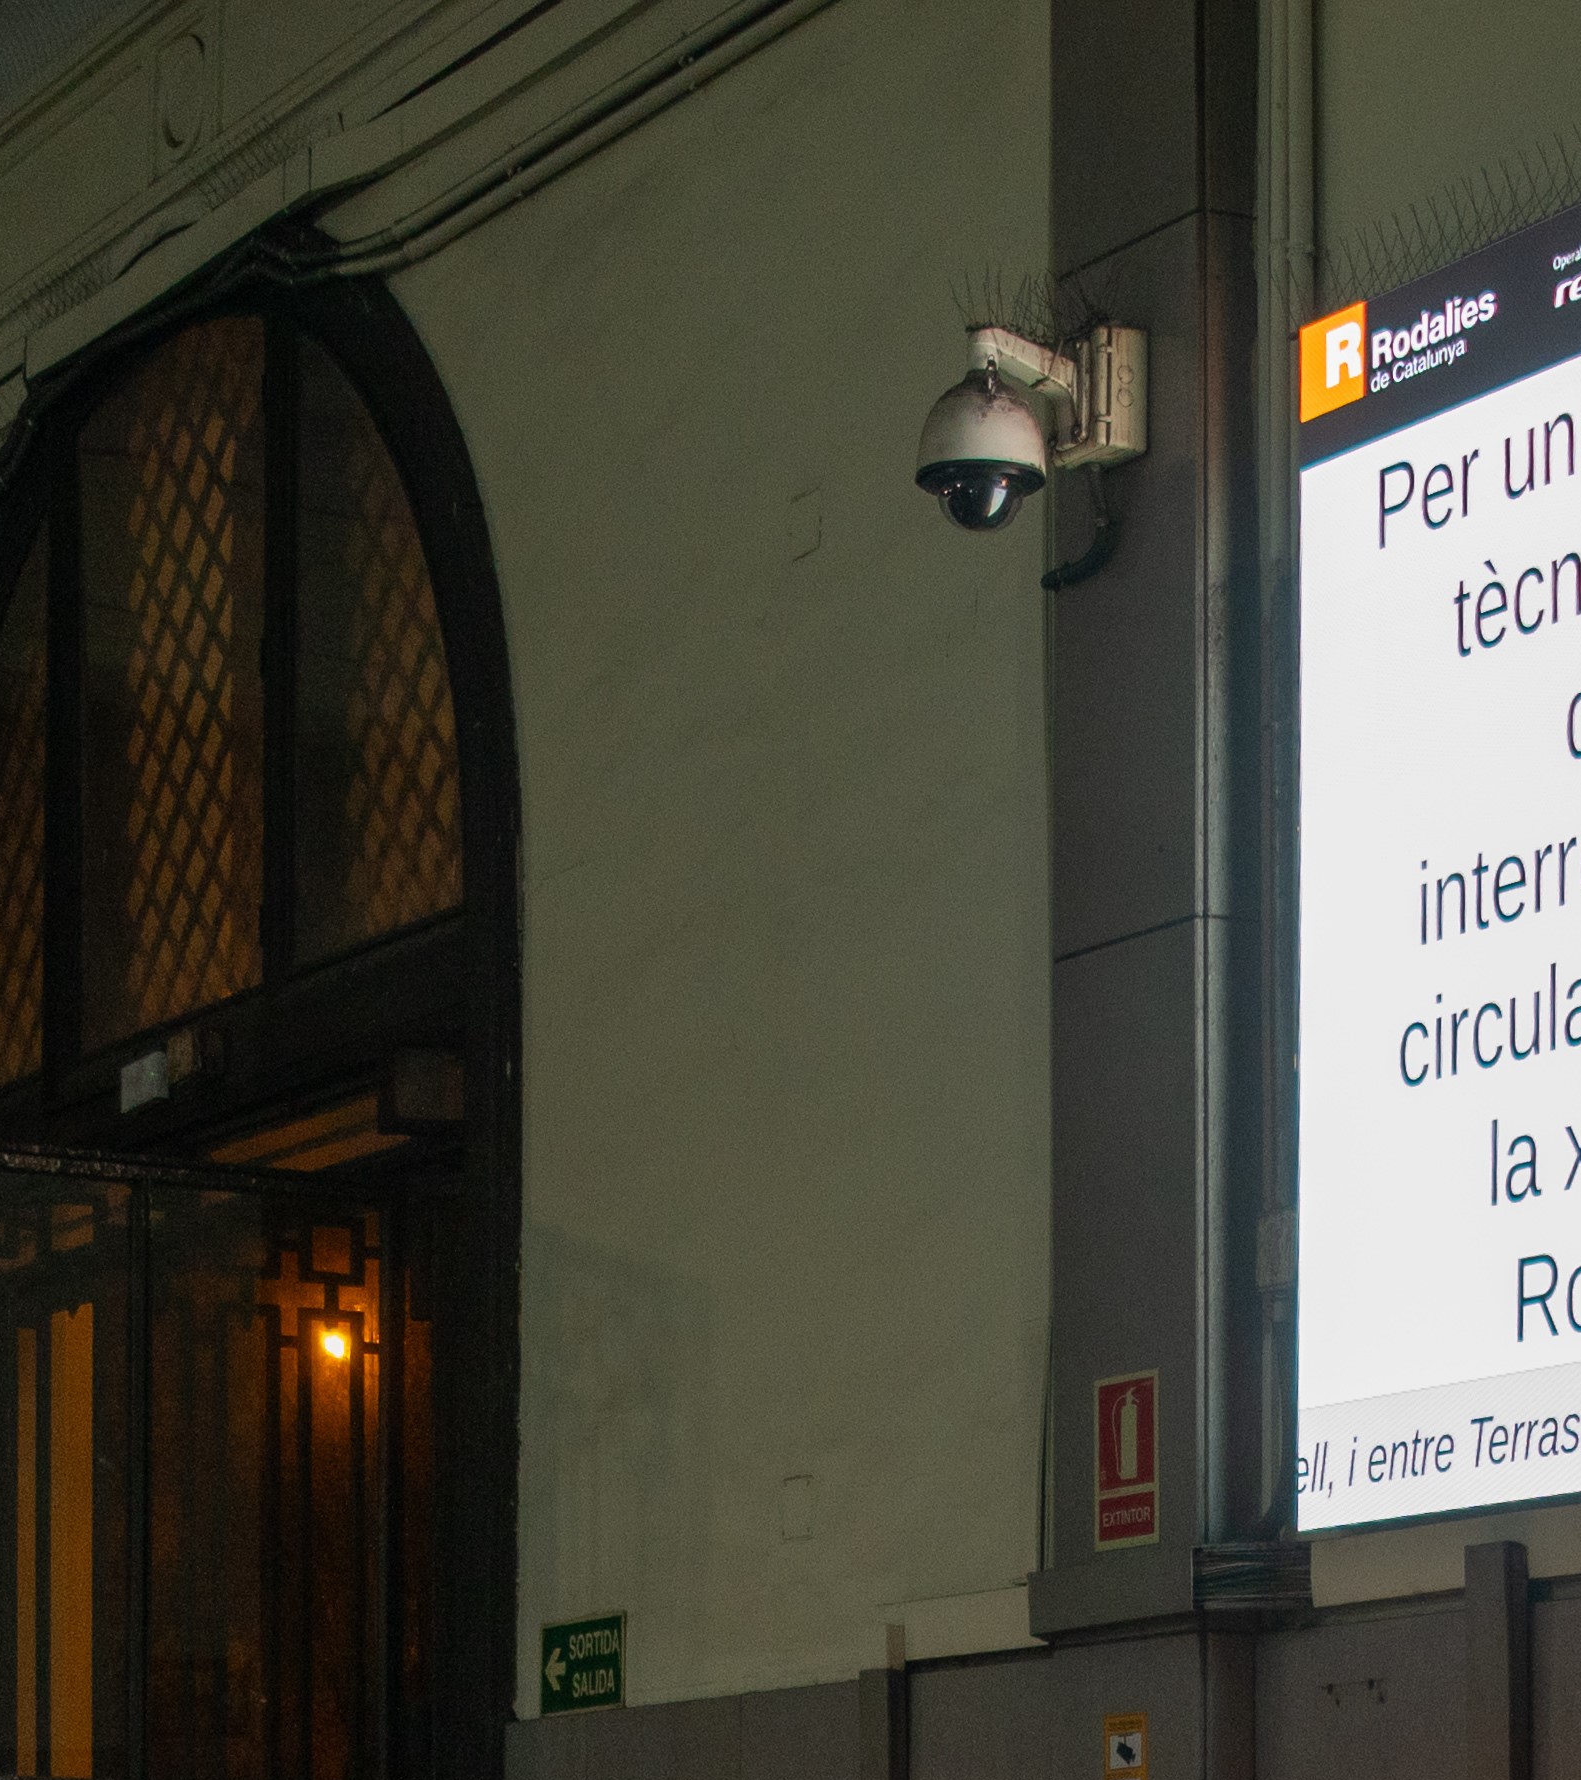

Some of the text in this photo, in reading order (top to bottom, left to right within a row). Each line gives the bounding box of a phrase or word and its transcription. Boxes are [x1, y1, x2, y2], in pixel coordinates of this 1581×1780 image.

[1326, 321, 1363, 388] R
[1371, 291, 1498, 369] Rodalies
[1371, 338, 1468, 392] de Catalunya
[1380, 450, 1478, 548] Per
[1492, 1120, 1541, 1205] la
[1348, 1436, 1358, 1487] i
[1369, 1431, 1454, 1482] entre
[1102, 1506, 1151, 1527] EXTINTOR
[569, 1628, 620, 1660] SORTIDA
[572, 1668, 615, 1698] SALIDA
